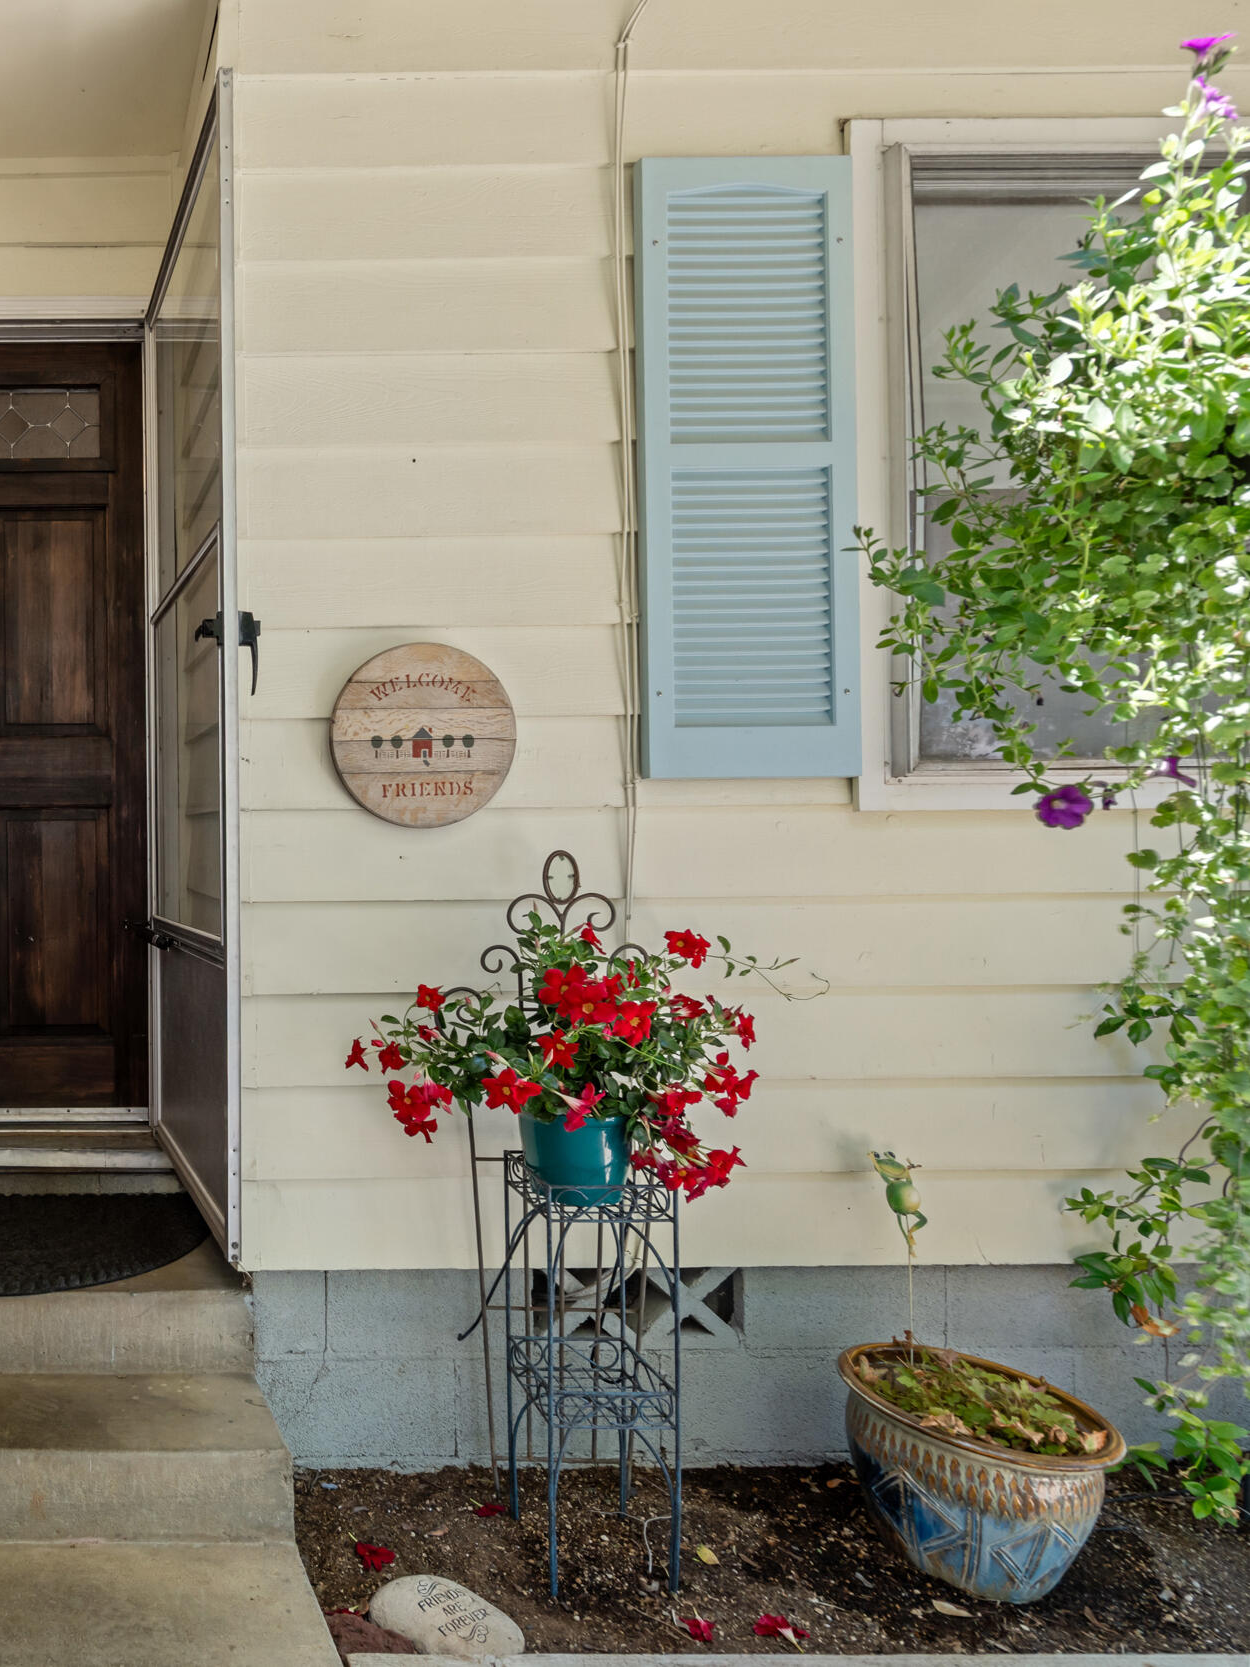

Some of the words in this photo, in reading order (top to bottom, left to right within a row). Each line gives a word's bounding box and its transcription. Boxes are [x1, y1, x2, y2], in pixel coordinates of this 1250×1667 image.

[370, 673, 477, 702] WELCOME
[382, 781, 473, 798] FRIENDS
[417, 1588, 466, 1612] FRIENDS
[442, 1601, 464, 1617] ARE
[438, 1608, 490, 1637] FOREVER
